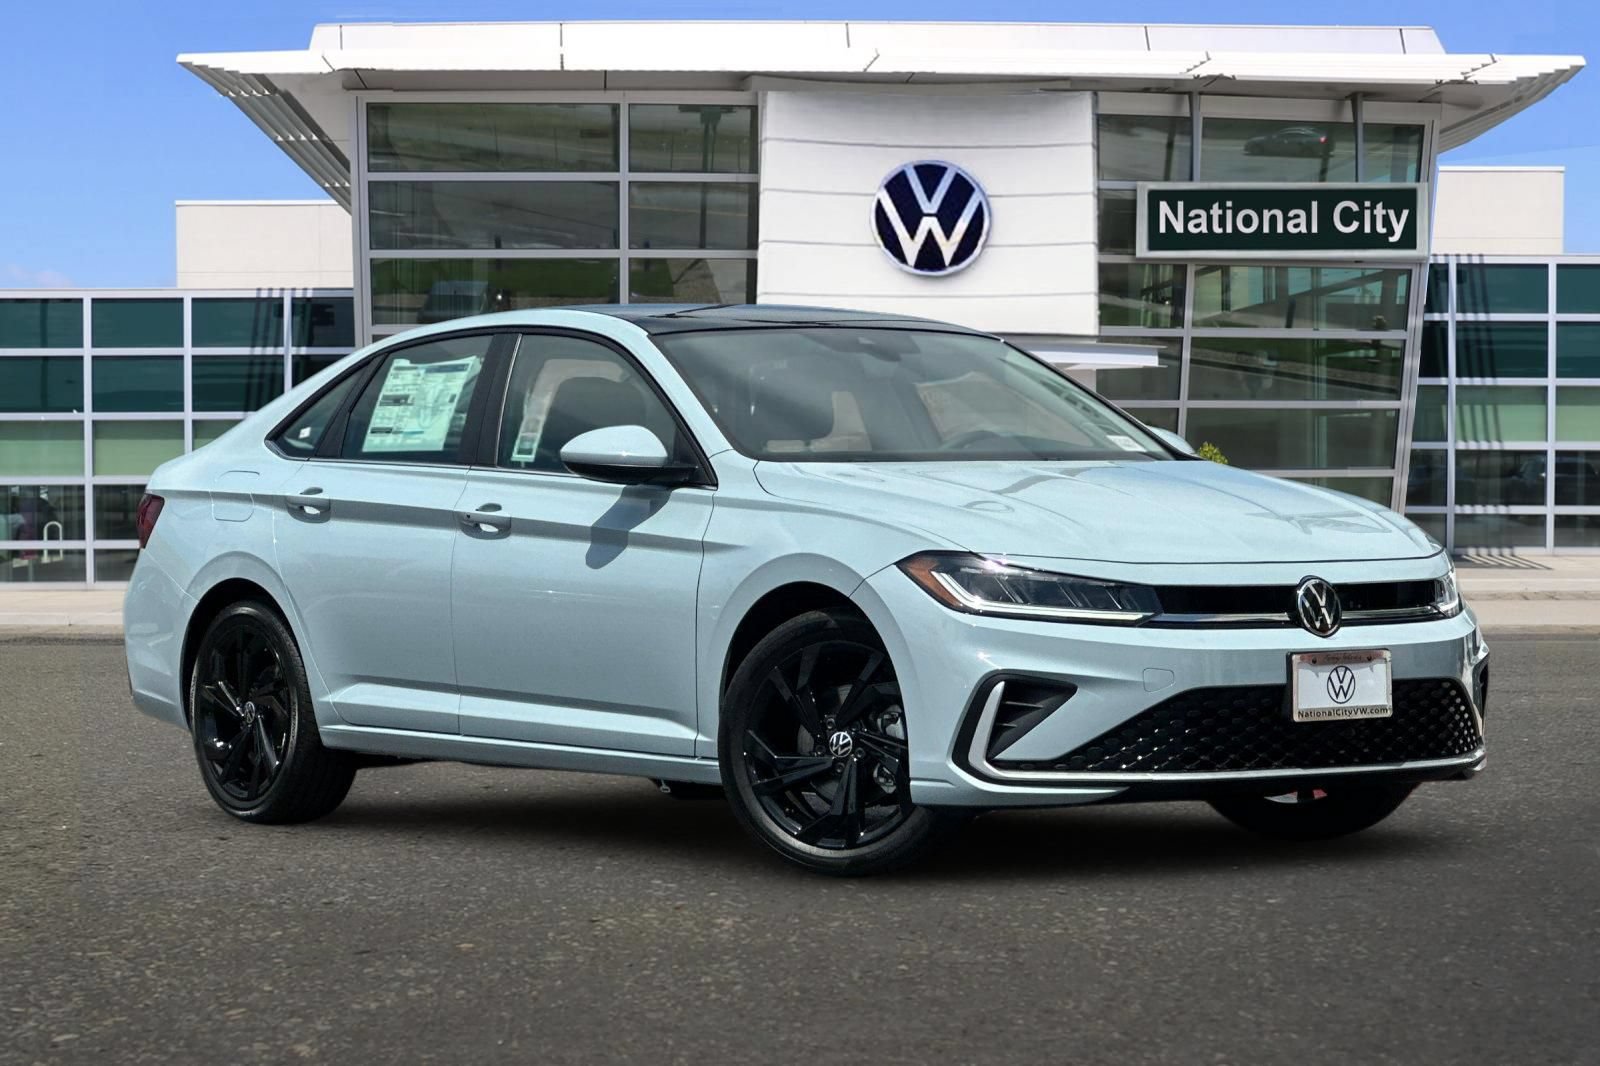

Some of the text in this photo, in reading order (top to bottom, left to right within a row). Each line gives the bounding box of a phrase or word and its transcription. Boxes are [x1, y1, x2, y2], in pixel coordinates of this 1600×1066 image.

[875, 163, 988, 272] VW
[1158, 200, 1410, 243] National City
[1298, 707, 1388, 718] NationalCityVW.com
